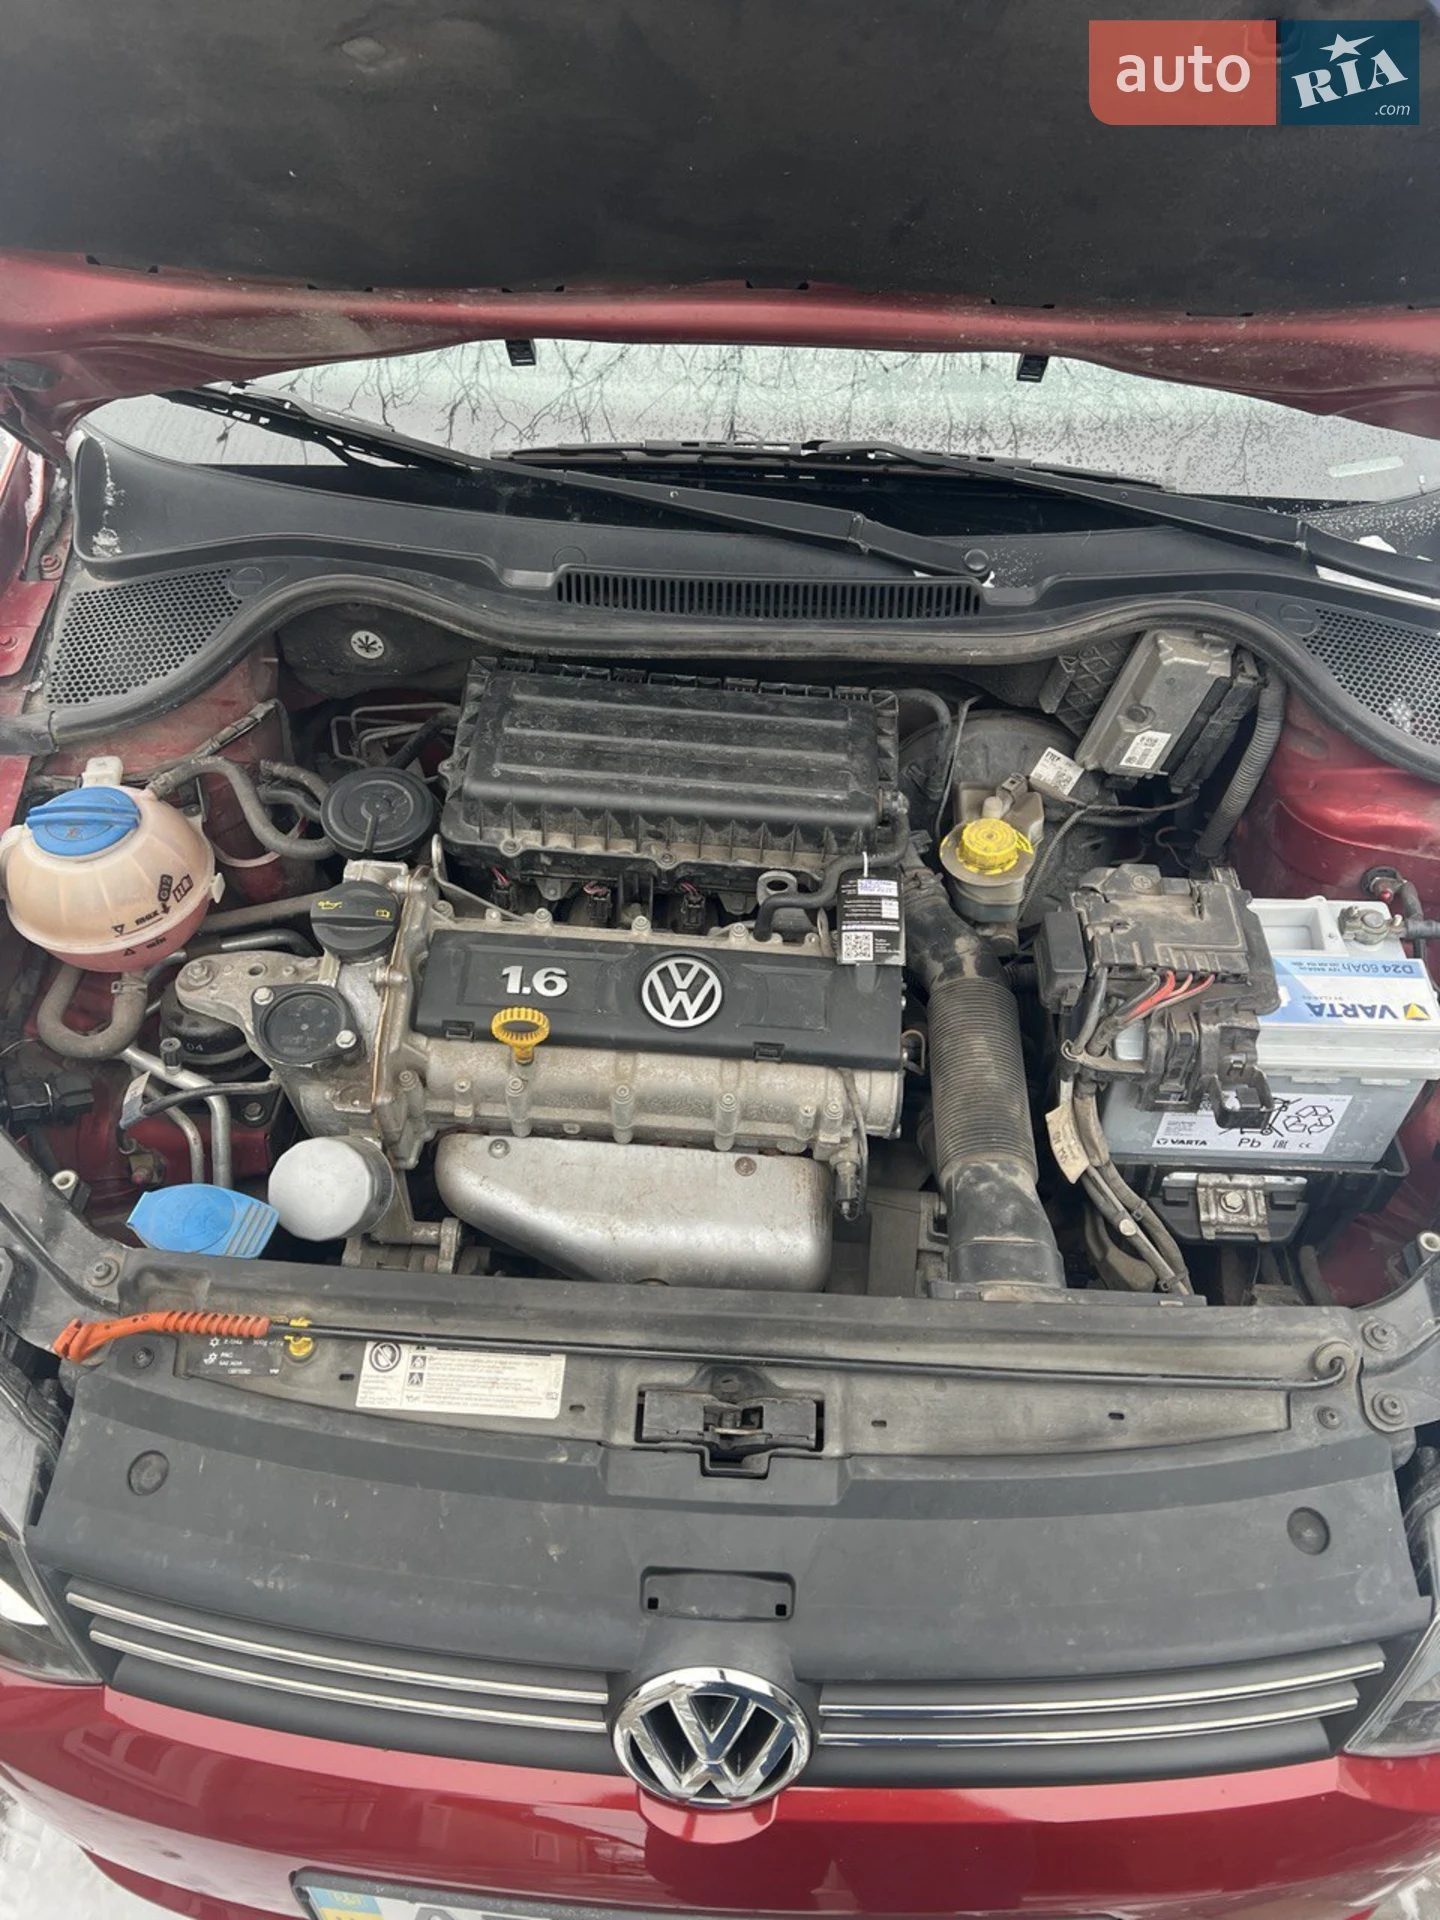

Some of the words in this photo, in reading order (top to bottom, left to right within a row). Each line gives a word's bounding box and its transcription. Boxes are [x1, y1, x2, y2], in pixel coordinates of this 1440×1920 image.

[134, 909, 160, 926] max
[1341, 962, 1379, 973] 60Ah
[1382, 965, 1414, 974] D24
[501, 965, 568, 997] 1.6
[1305, 1002, 1399, 1019] VARTA
[1170, 1138, 1208, 1146] VARTA
[1238, 1138, 1262, 1149] Pb
